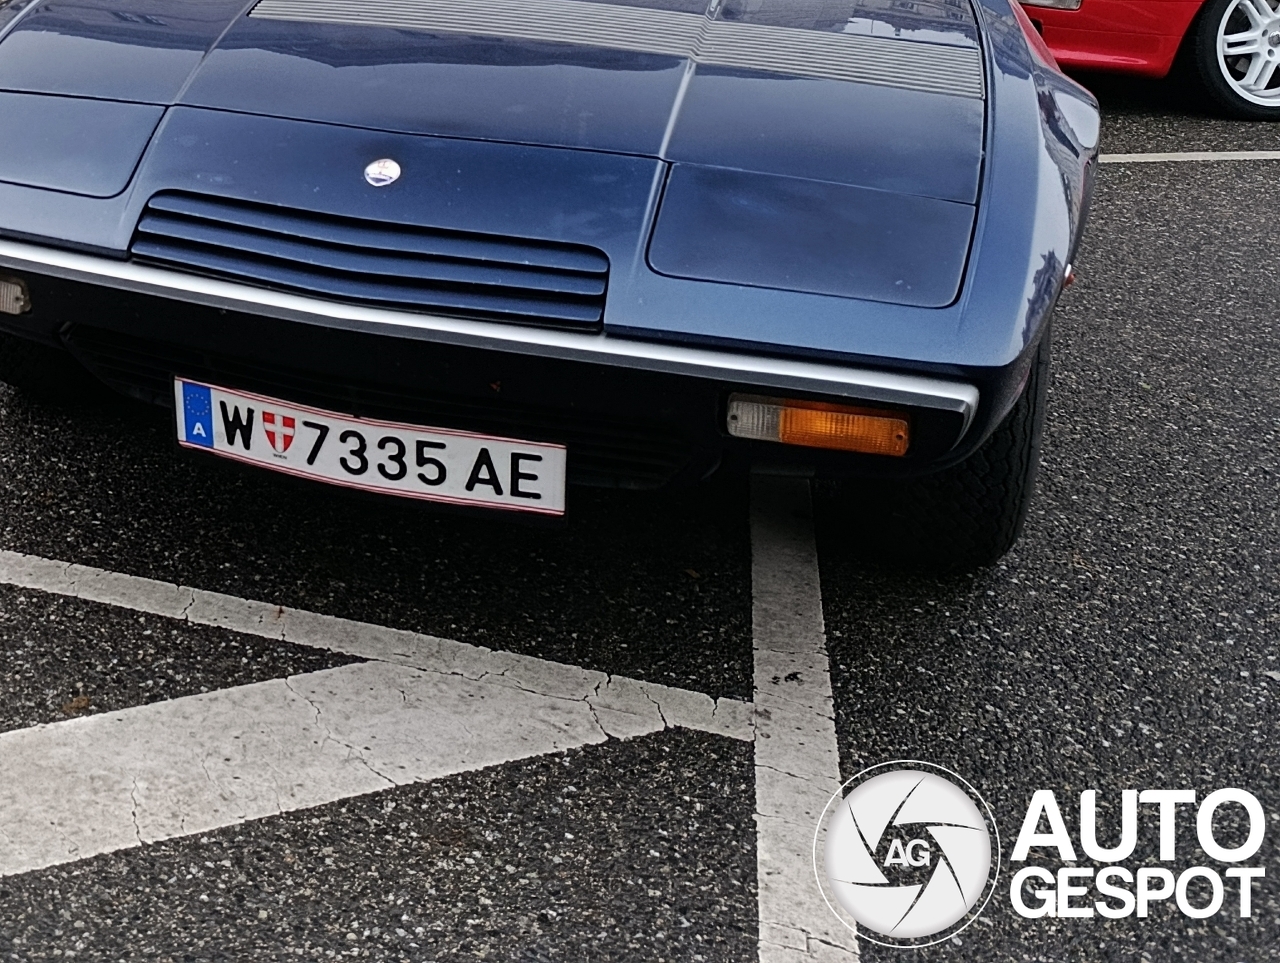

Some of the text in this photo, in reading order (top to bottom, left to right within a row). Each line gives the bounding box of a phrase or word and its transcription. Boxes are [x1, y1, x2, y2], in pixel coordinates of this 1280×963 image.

[192, 422, 207, 438] A
[220, 400, 543, 499] W 7335 AE
